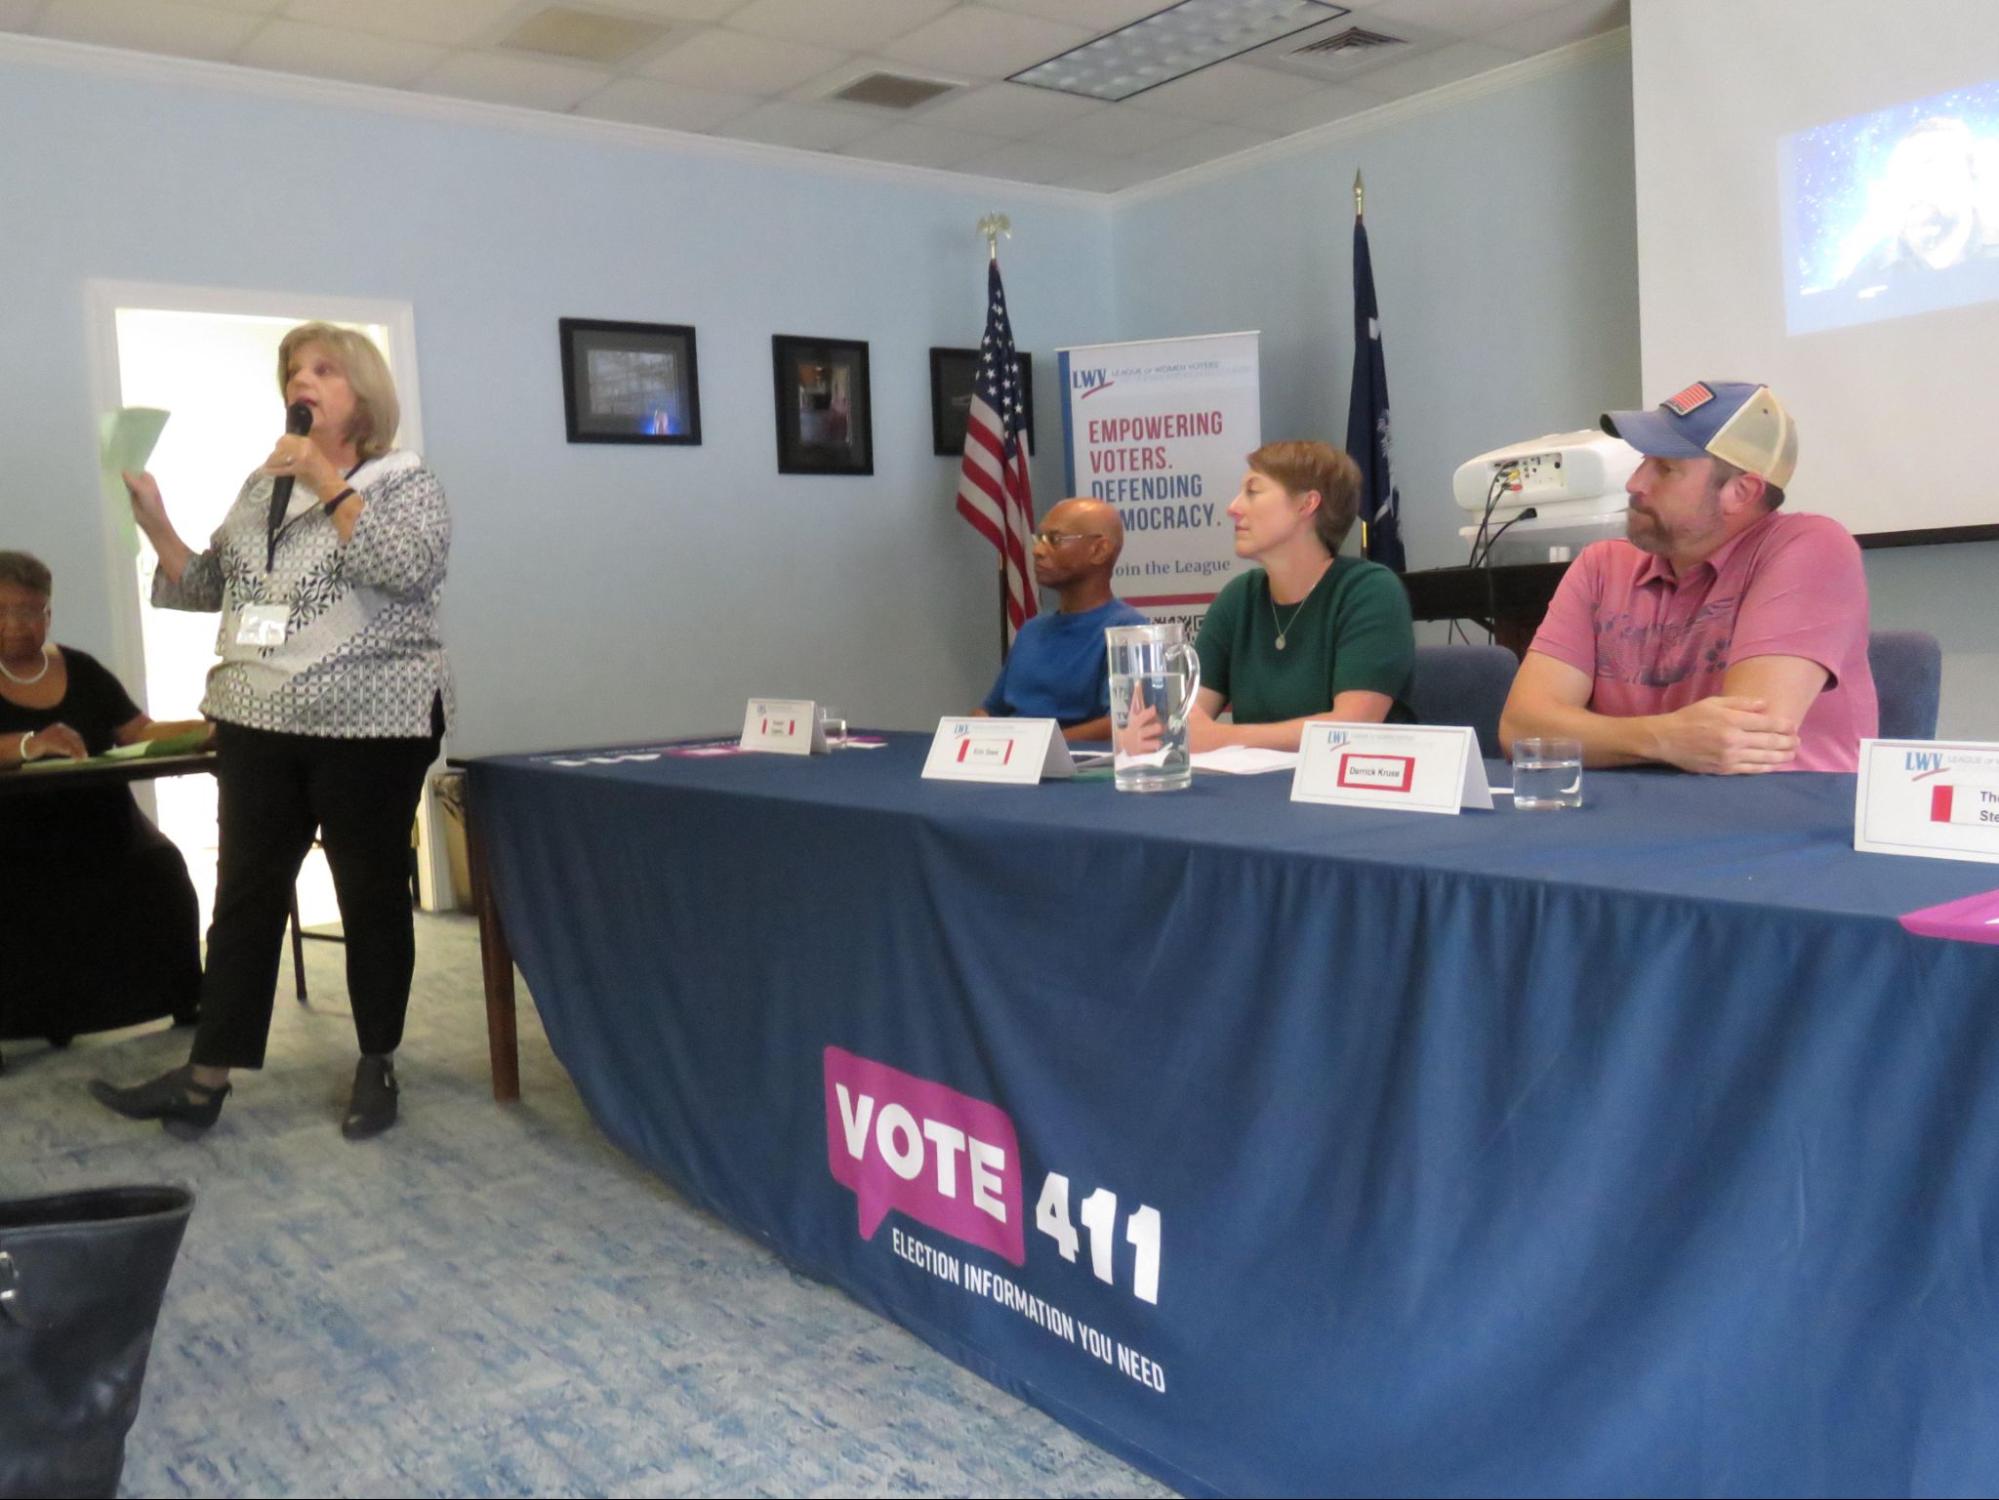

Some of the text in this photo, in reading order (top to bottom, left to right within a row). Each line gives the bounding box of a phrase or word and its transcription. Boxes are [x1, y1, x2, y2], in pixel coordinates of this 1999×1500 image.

[1073, 367, 1107, 388] LWV
[1155, 363, 1186, 374] WOMEN
[1088, 411, 1223, 444] EMPOWERING
[1090, 446, 1173, 474] VOTERS.
[1092, 474, 1203, 503] DEFENDING
[1120, 503, 1222, 532] MOCRACY.
[1115, 559, 1231, 577] oin the League
[1905, 751, 1943, 771] LWV
[1980, 790, 1999, 803] Th
[836, 1082, 1007, 1225] VOTE
[1035, 1170, 1162, 1306] 411
[892, 1226, 1166, 1394] ELECTION INFORMATION YOU NEED
